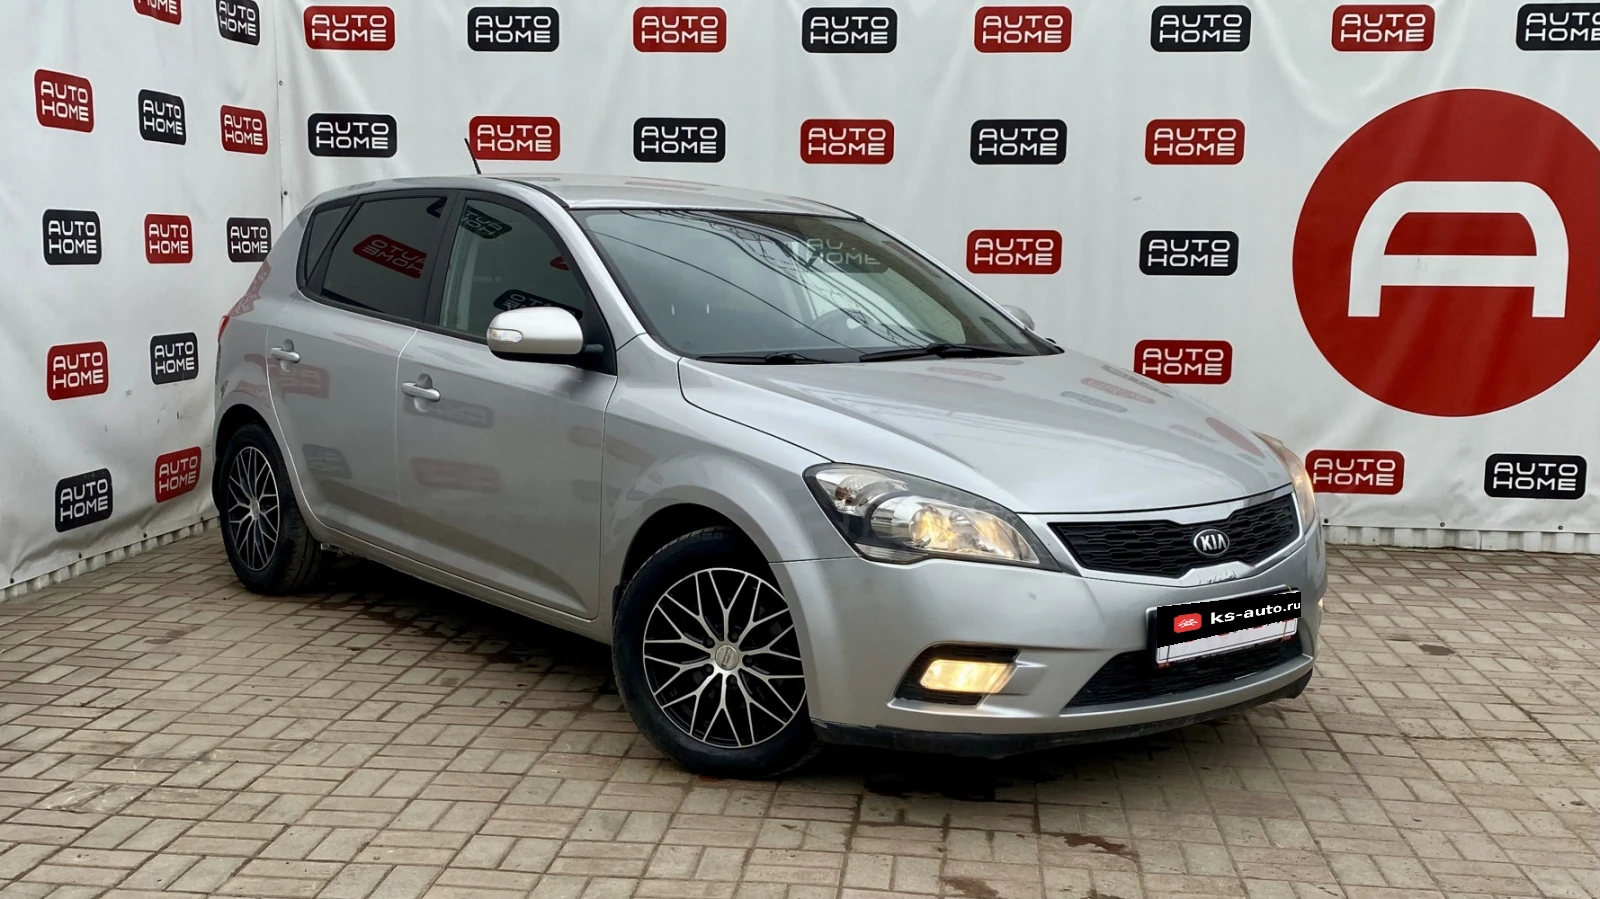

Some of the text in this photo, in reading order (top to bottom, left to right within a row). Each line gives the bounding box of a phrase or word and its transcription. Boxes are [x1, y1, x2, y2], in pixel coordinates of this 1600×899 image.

[138, 0, 178, 15] OME
[219, 1, 256, 21] AUTO
[220, 16, 257, 36] HOME
[312, 14, 386, 27] AUTO
[476, 16, 551, 28] AUTO
[642, 16, 718, 28] AUTO
[811, 17, 889, 29] AUTO
[984, 15, 1063, 28] AUTO
[1160, 14, 1242, 27] AUTO
[1342, 14, 1426, 26] AUTO
[312, 29, 386, 41] HOME
[476, 30, 550, 43] HOME
[642, 31, 717, 43] HOME
[810, 32, 887, 44] HOME
[983, 31, 1061, 43] HOME
[1160, 30, 1240, 42] HOME
[1341, 29, 1424, 42] HOME
[41, 81, 88, 103] AUTO
[42, 100, 89, 121] HOME
[143, 100, 181, 119] AUTO
[144, 116, 183, 135] HOME
[224, 115, 262, 131] AUTO
[316, 122, 389, 134] AUTO
[225, 130, 263, 145] HOME
[478, 125, 552, 137] AUTO
[642, 126, 717, 139] AUTO
[809, 128, 886, 140] AUTO
[979, 128, 1058, 140] AUTO
[1155, 128, 1236, 140] AUTO
[316, 136, 388, 149] HOME
[478, 139, 551, 152] HOME
[642, 141, 716, 153] HOME
[809, 143, 884, 155] HOME
[979, 143, 1057, 155] HOME
[1154, 143, 1234, 155] HOME
[49, 220, 96, 236] AUTO
[149, 224, 188, 237] AUTO
[231, 227, 267, 238] AUTO
[49, 239, 97, 254] HOME
[150, 241, 188, 253] HOME
[231, 241, 268, 253] HOME
[806, 238, 857, 251] AU
[975, 239, 1053, 250] AUTO
[1149, 240, 1230, 252] AUTO
[975, 253, 1052, 265] HOME
[1148, 254, 1228, 267] HOME
[155, 342, 194, 358] AUTO
[1143, 349, 1223, 361] AUTO
[54, 352, 103, 371] AUTO
[156, 357, 194, 374] HOME
[1143, 363, 1222, 375] HOME
[53, 369, 103, 389] HOME
[159, 455, 198, 478] AUTO
[1314, 459, 1395, 471] AUTO
[1494, 462, 1578, 476] AUTO
[159, 473, 197, 493] HOME
[1313, 473, 1393, 486] HOME
[1493, 477, 1576, 490] HOME
[61, 479, 107, 504] AUTO
[61, 496, 107, 521] HOME
[1200, 534, 1227, 551] KIA
